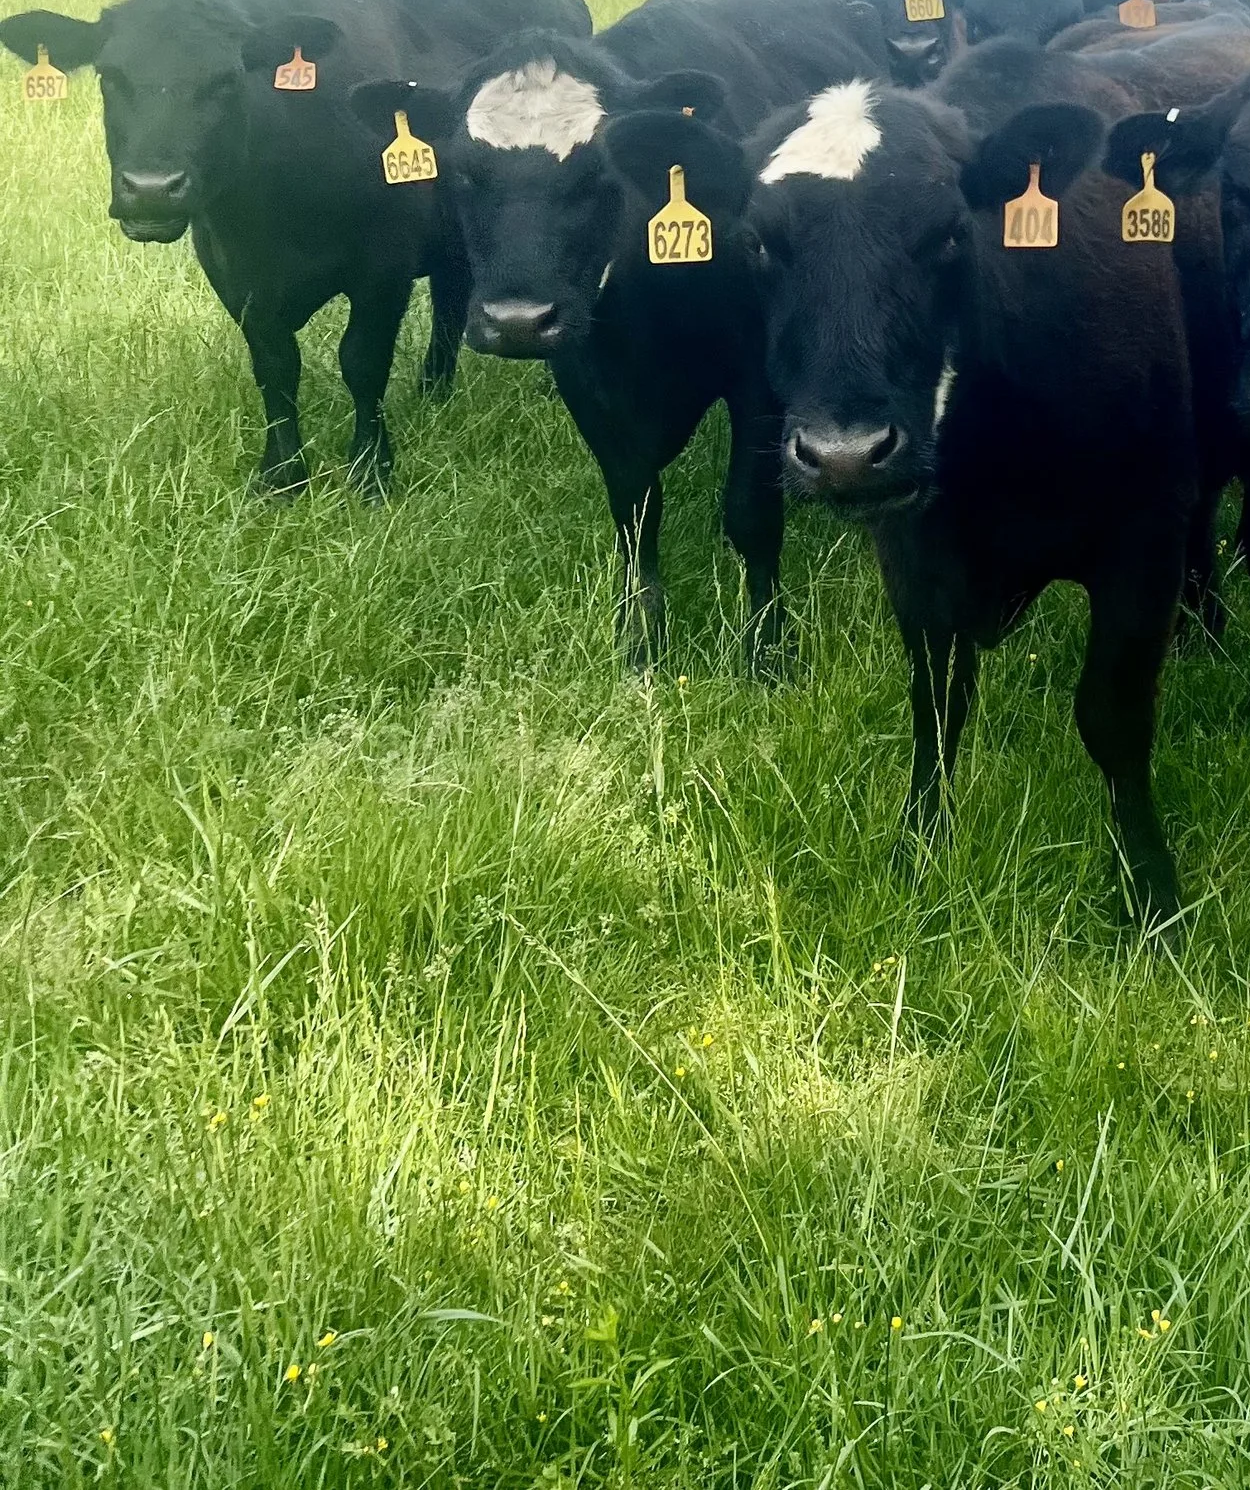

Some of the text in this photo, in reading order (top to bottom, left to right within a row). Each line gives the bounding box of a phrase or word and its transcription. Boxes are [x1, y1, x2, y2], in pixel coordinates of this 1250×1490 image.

[26, 76, 65, 98] 6587
[278, 67, 314, 88] 545
[387, 148, 433, 179] 6645
[1127, 209, 1170, 239] 3586
[654, 220, 709, 259] 6273
